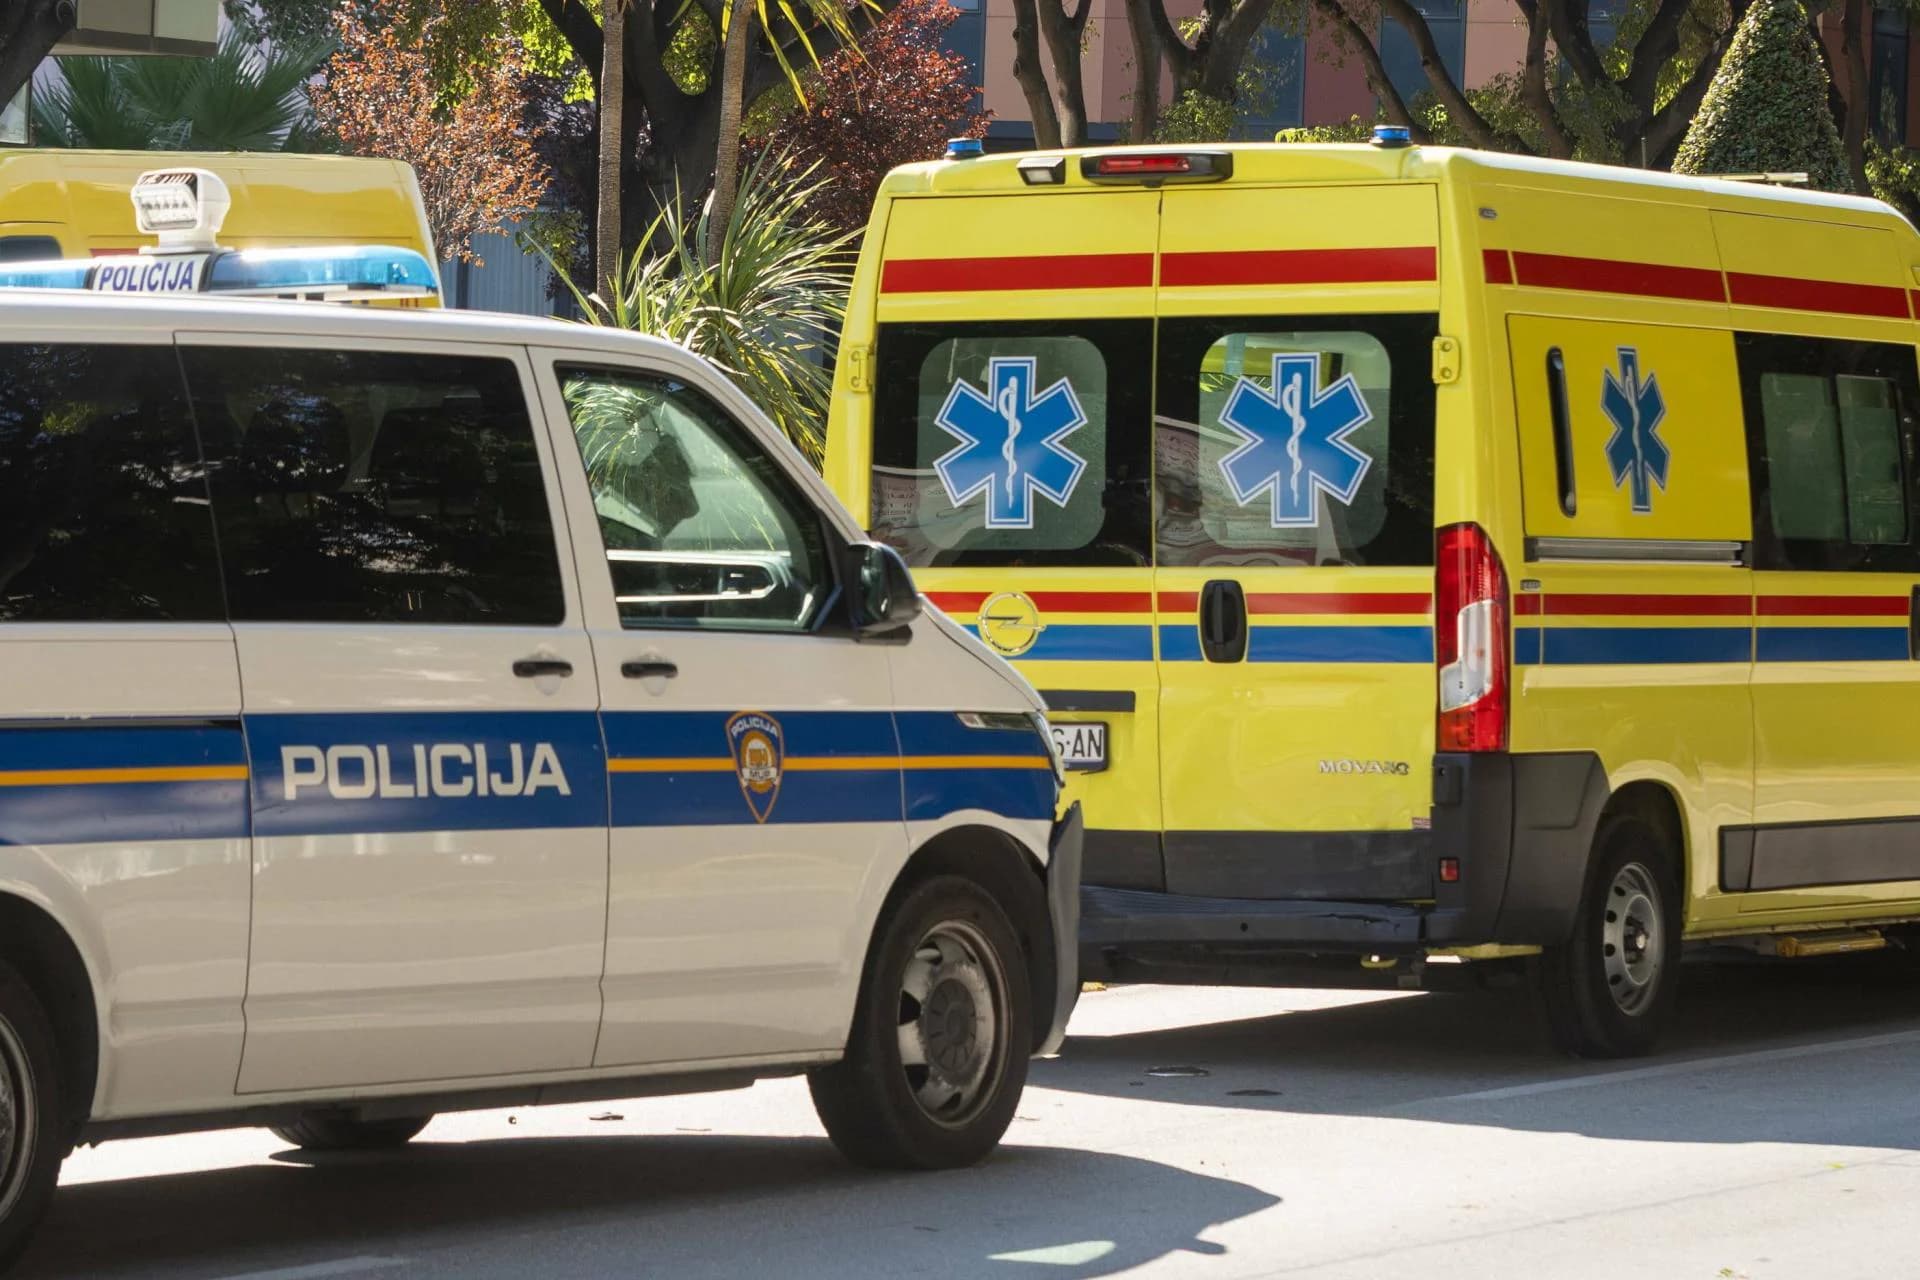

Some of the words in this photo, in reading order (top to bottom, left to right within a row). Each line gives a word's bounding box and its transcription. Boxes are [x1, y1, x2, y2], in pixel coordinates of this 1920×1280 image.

[98, 261, 194, 291] POLICIJA
[731, 716, 777, 737] POLICIJA
[281, 743, 571, 800] POLICIJA
